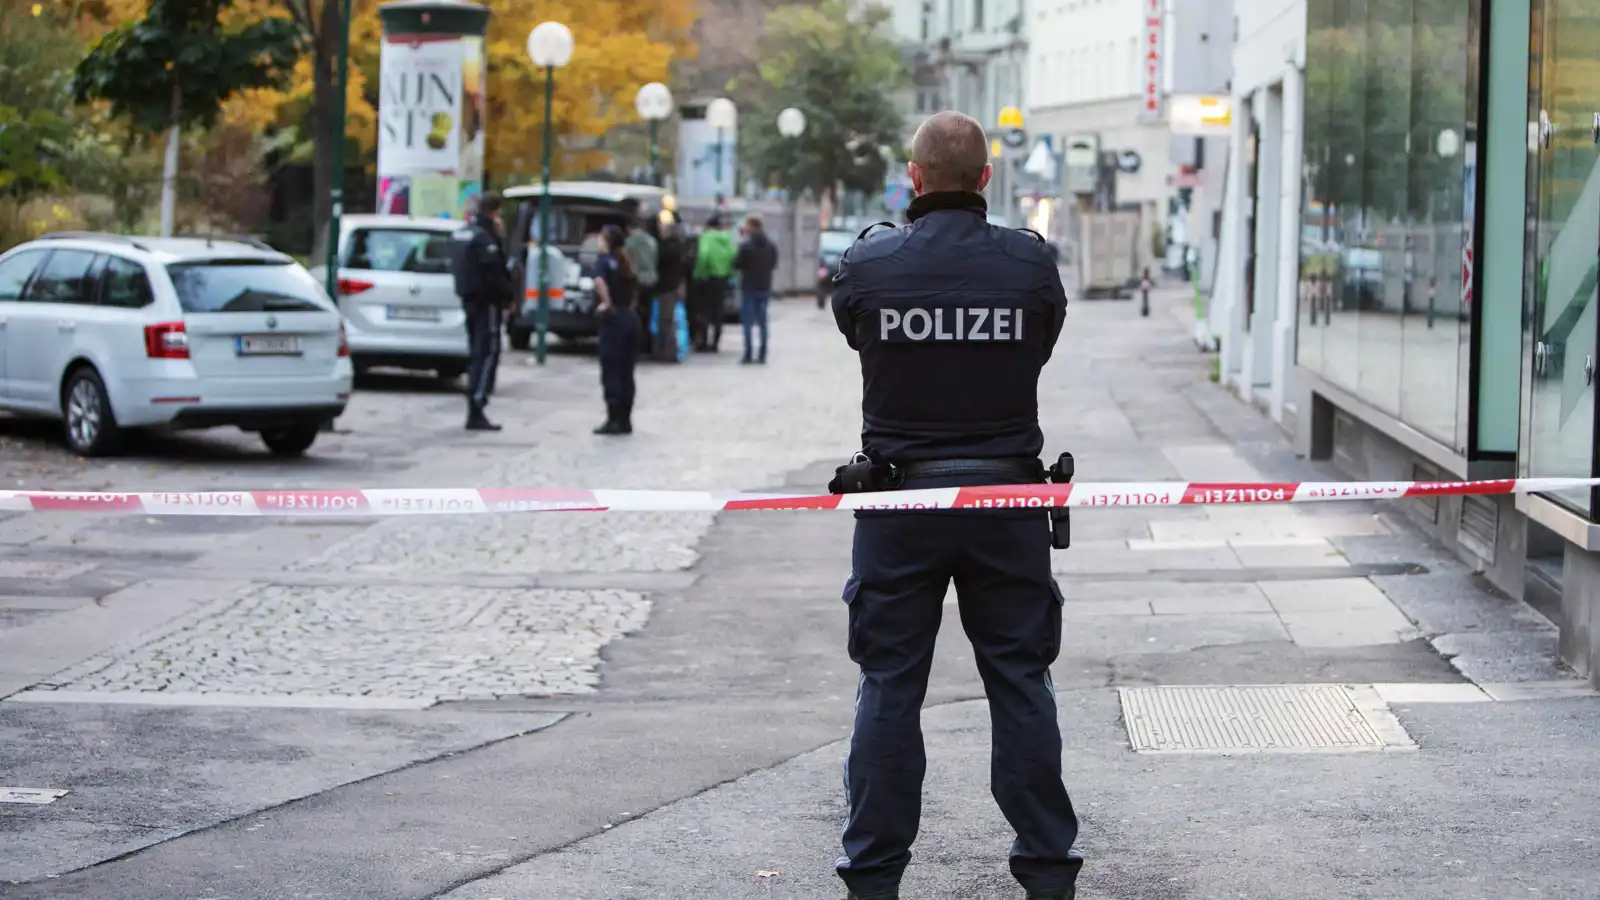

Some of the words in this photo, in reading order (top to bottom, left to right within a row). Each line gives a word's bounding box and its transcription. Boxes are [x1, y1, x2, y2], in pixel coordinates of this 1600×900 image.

[880, 308, 1023, 340] POLIZEI
[1092, 493, 1170, 505] POLIZEI
[1205, 488, 1284, 503] POLIZEI
